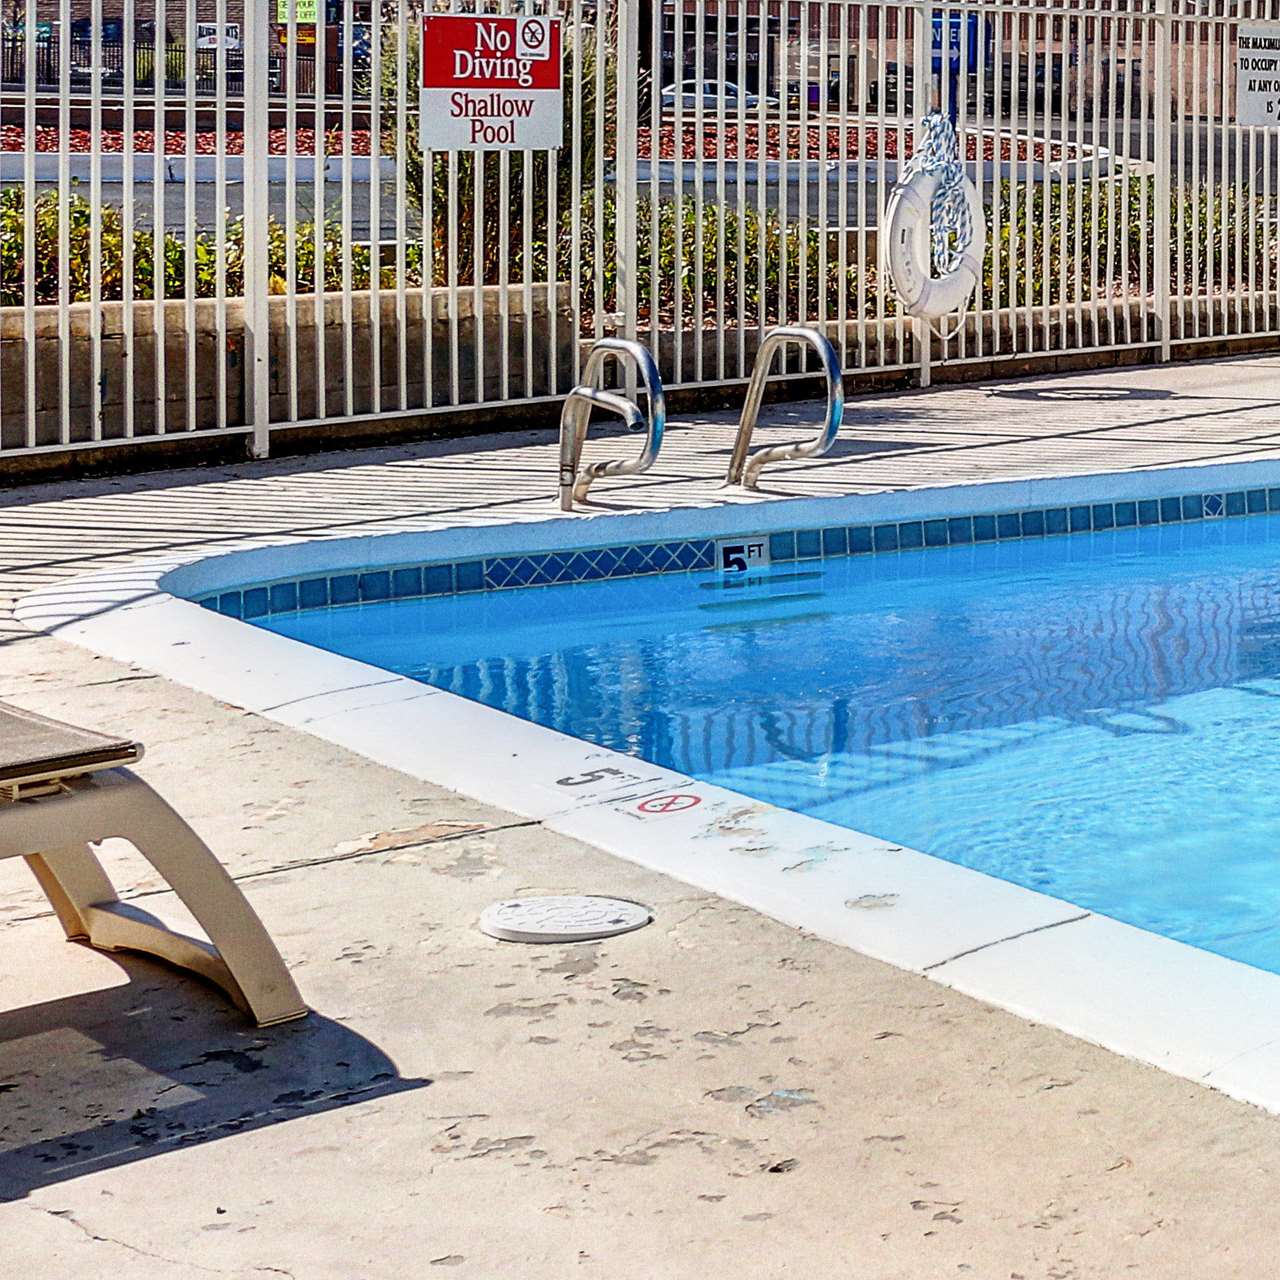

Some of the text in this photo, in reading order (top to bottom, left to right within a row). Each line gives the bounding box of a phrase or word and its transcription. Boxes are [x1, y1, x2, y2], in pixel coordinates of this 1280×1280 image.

[474, 22, 511, 51] No
[1238, 36, 1250, 49] THE
[452, 49, 533, 87] Diving
[1240, 57, 1249, 70] TO
[1251, 58, 1278, 71] OCCUPY
[1248, 79, 1256, 92] AT
[1257, 80, 1272, 92] ANY
[450, 91, 535, 118] Shallow
[1266, 100, 1273, 113] IS
[470, 119, 516, 144] Pool
[722, 543, 764, 573] 5 FT
[555, 767, 626, 787] 5
